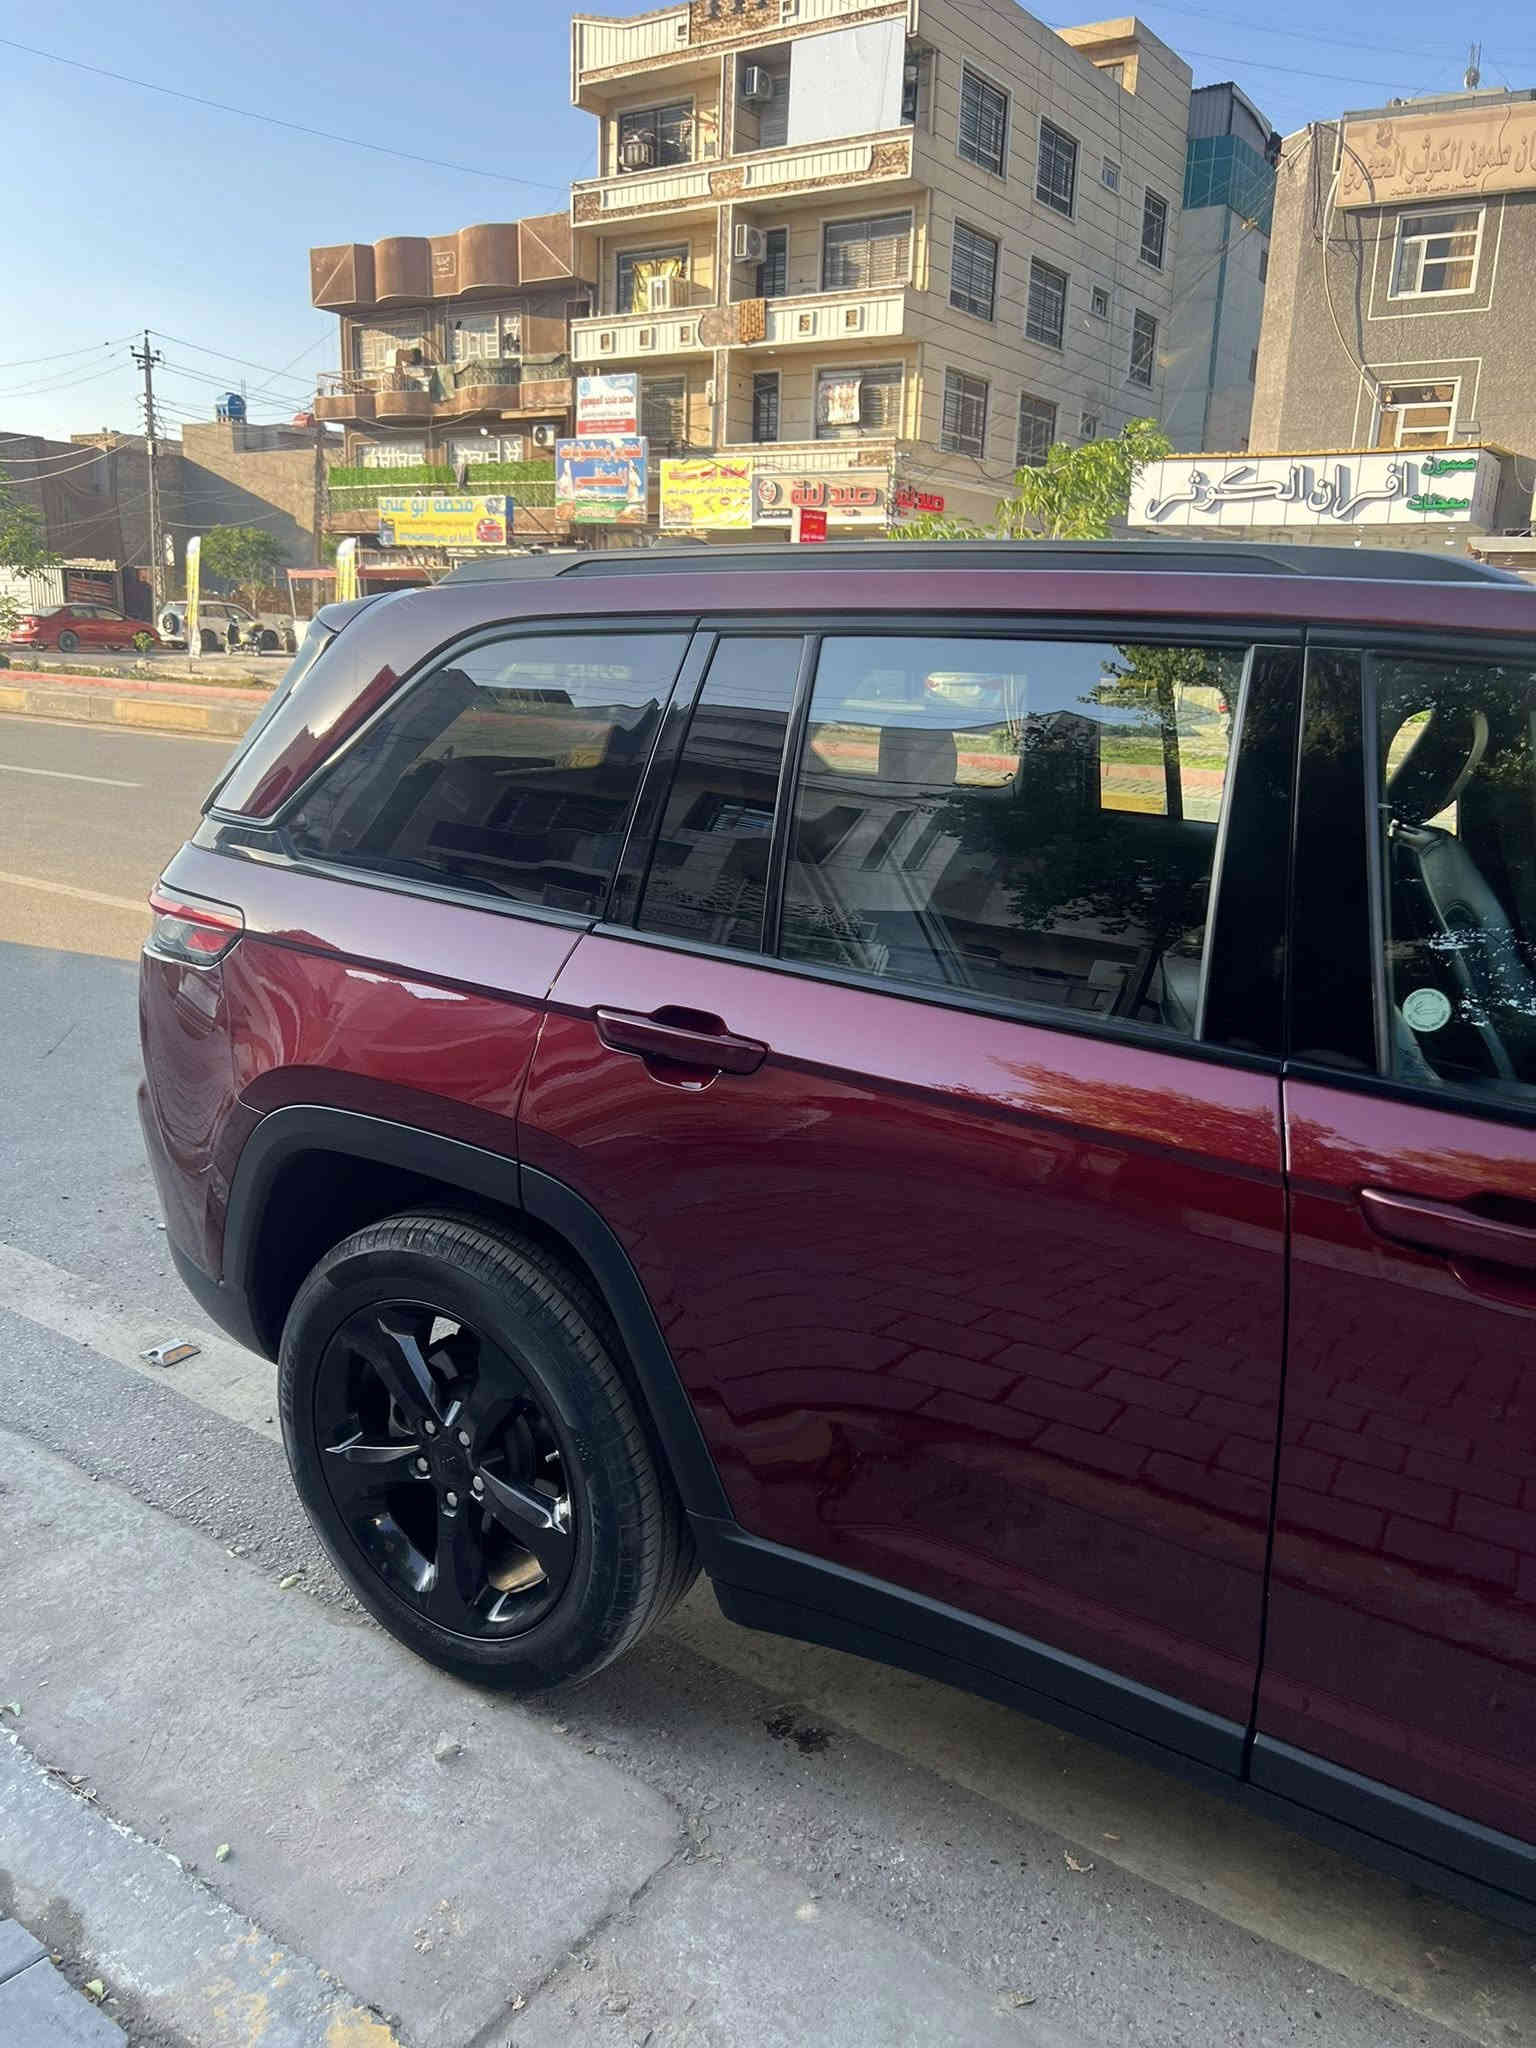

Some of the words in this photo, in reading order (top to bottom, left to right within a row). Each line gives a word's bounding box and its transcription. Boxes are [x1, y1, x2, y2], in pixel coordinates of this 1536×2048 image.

[1421, 455, 1476, 475] صمون
[1145, 465, 1304, 519] الكوثر
[1306, 461, 1408, 518] افران
[1406, 493, 1469, 511] معجنات
